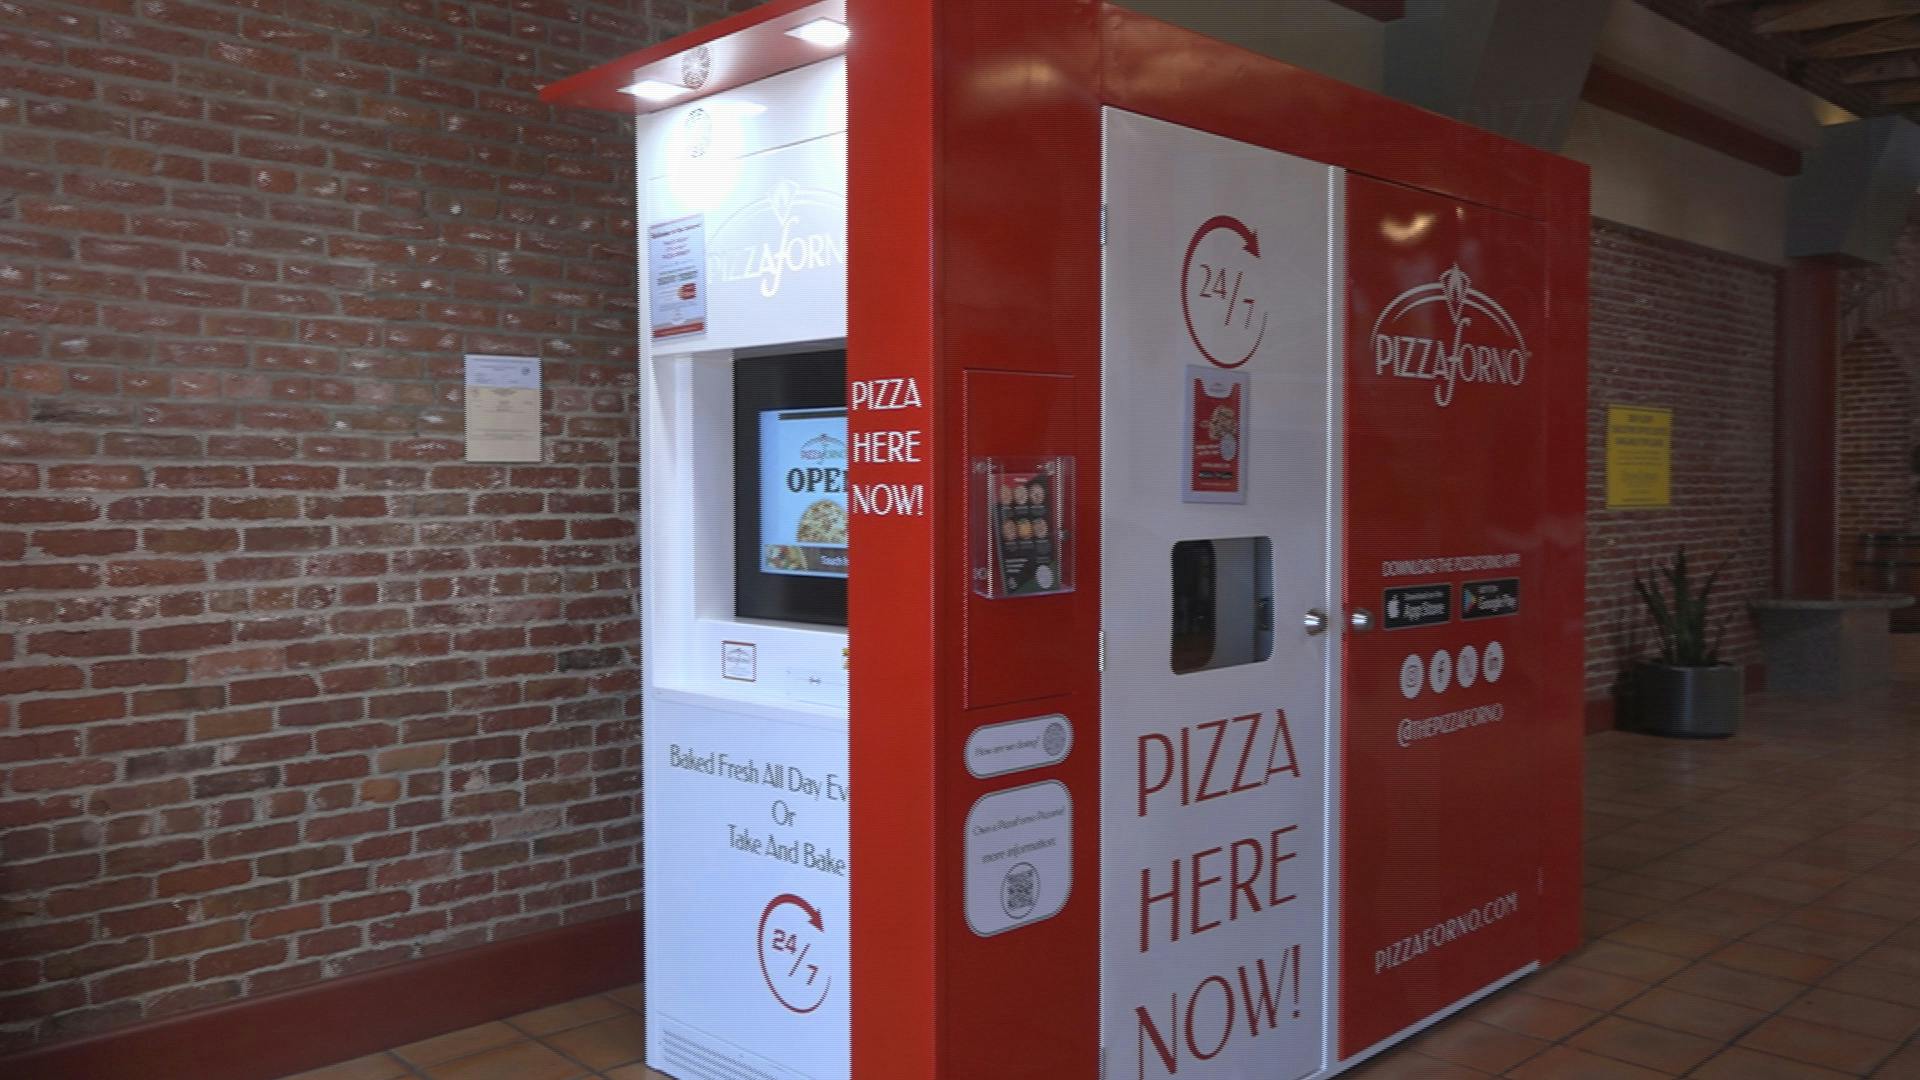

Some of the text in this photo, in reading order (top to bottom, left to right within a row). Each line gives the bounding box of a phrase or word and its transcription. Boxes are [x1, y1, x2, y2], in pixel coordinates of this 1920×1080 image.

[1198, 264, 1256, 329] 24/7
[851, 378, 922, 411] PIZZA
[852, 430, 922, 463] HERE
[852, 483, 924, 516] NOW!
[1382, 558, 1437, 577] DOWNLOAD
[1438, 558, 1454, 572] THE
[1397, 702, 1503, 747] @THEPIZZAFORNO
[670, 743, 715, 776] Baked
[719, 752, 759, 785] Fresh
[762, 761, 784, 790] All
[788, 766, 822, 801] Day
[1137, 708, 1302, 817] PIZZA
[772, 799, 797, 827] Or
[728, 823, 846, 877] Take And Bake
[1139, 824, 1299, 953] HERE
[771, 928, 819, 987] 24/7
[1374, 891, 1518, 975] PIZZAFORNO.COM
[1134, 943, 1302, 1080] NOW!
